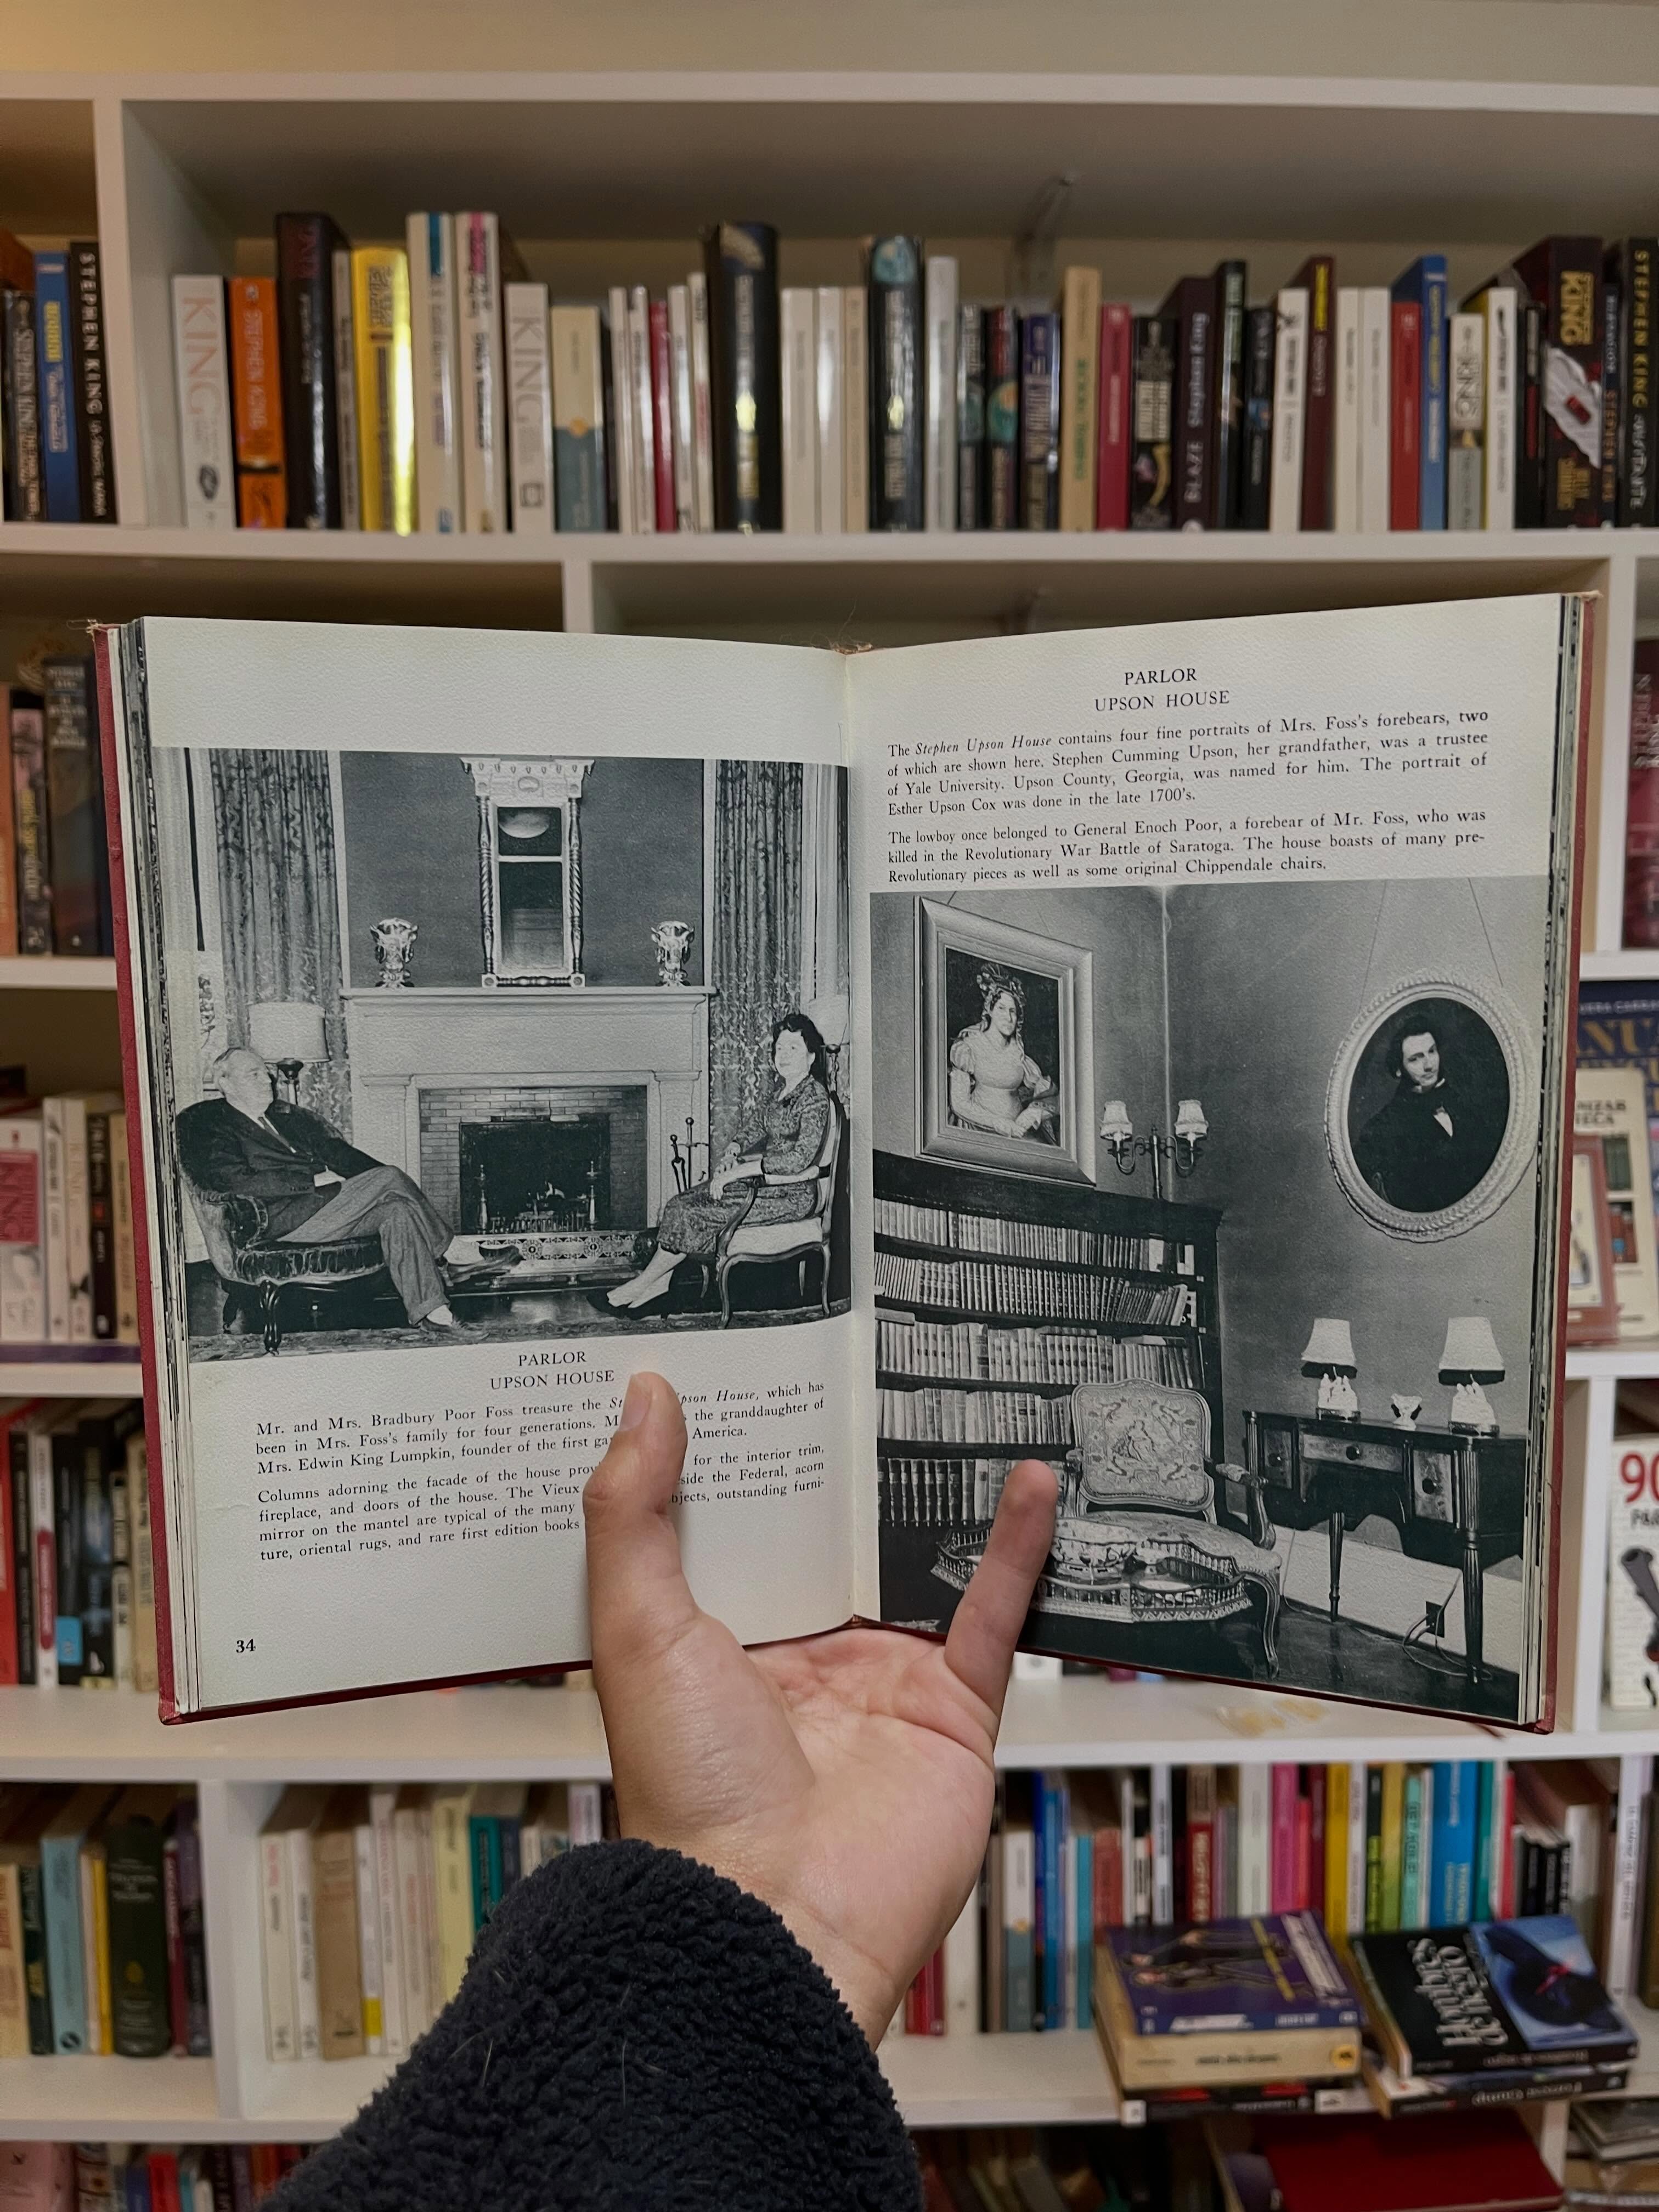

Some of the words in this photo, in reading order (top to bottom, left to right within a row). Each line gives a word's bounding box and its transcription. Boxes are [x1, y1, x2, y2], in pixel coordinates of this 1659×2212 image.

[79, 252, 99, 351] STEPHEN
[1634, 250, 1650, 347] STEPHEN
[182, 297, 223, 415] KING
[512, 316, 544, 422] KING
[84, 358, 103, 415] KING
[1632, 353, 1649, 408] KING
[1124, 668, 1198, 686] PARLOR
[1094, 695, 1155, 712] UPSON
[1166, 690, 1229, 708] HOUSE
[887, 743, 910, 758] The
[915, 741, 959, 757] Stephen
[967, 738, 1004, 754] Upson
[1011, 735, 1052, 749] House
[1058, 730, 1112, 746] contains
[1120, 728, 1149, 742] four
[1156, 725, 1182, 740] fine
[1189, 721, 1250, 741] portraits
[1257, 719, 1271, 733] of
[1280, 718, 1316, 732] Mrs.
[1325, 713, 1368, 730] Foss's
[1377, 711, 1450, 727] forebears,
[1459, 712, 1488, 723] two
[888, 763, 898, 777] of
[904, 760, 937, 776] which
[944, 763, 962, 773] are
[968, 758, 1006, 771] shown
[1014, 755, 1044, 769] here.
[1052, 751, 1103, 768] Stephen
[1111, 747, 1180, 763] Cumming
[1189, 744, 1238, 761] Upson,
[1248, 741, 1270, 755] her
[1278, 736, 1370, 758] grandfather,
[1380, 738, 1409, 748] was
[1418, 737, 1426, 747] a
[1436, 733, 1488, 746] trustee
[888, 801, 923, 816] Esther
[929, 800, 966, 815] Upson
[972, 798, 996, 811] Cox
[1002, 799, 1026, 810] was
[1032, 794, 1062, 808] done
[1069, 793, 1081, 806] in
[1088, 791, 1109, 805] the
[1116, 790, 1141, 804] late
[1150, 787, 1195, 803] 1700's.
[888, 850, 918, 864] killed
[924, 849, 934, 862] in
[941, 848, 958, 862] the
[965, 845, 1052, 861] Revolutionary
[1060, 843, 1092, 857] War
[1099, 841, 1140, 856] Battle
[1148, 840, 1161, 854] of
[1170, 839, 1234, 855] Saratoga.
[1242, 836, 1273, 850] The
[1282, 834, 1322, 849] house
[1330, 833, 1373, 848] boasts
[1381, 831, 1396, 846] of
[1406, 834, 1447, 847] many
[1455, 833, 1485, 847] pre-
[889, 868, 967, 883] Revolutionary
[973, 866, 1007, 883] pieces
[1014, 870, 1026, 878] as
[1032, 864, 1059, 878] well
[1066, 868, 1079, 877] as
[1086, 867, 1118, 876] some
[1125, 860, 1177, 878] original
[1185, 856, 1273, 875] Chippendale
[1280, 855, 1326, 870] chairs.
[490, 1374, 548, 1390] UPSON
[557, 1369, 614, 1385] HOUSE
[518, 1351, 587, 1367] PARLOR
[256, 1422, 284, 1436] Mr.
[294, 1418, 318, 1433] and
[328, 1417, 361, 1430] Mrs.
[371, 1412, 435, 1427] Bradbury
[445, 1409, 476, 1421] Poor
[486, 1406, 514, 1418] Foss
[522, 1404, 573, 1415] treasure
[582, 1398, 601, 1411] the
[677, 1392, 707, 1406] pson
[716, 1389, 759, 1402] House,
[766, 1383, 801, 1399] which
[809, 1381, 824, 1393] has
[256, 1442, 286, 1455] been
[295, 1439, 307, 1452] in
[316, 1436, 350, 1450] Mrs.
[359, 1432, 398, 1447] Foss's
[406, 1428, 448, 1443] family
[456, 1426, 476, 1439] for
[484, 1424, 512, 1437] four
[520, 1418, 595, 1437] generations.
[695, 1408, 713, 1421] the
[720, 1402, 808, 1422] granddaughter
[814, 1396, 823, 1410] of
[257, 1461, 291, 1475] Mrs.
[298, 1456, 343, 1471] Edwin
[351, 1453, 383, 1467] King
[390, 1447, 455, 1463] Lumpkin,
[461, 1442, 512, 1457] founder
[517, 1440, 531, 1453] of
[537, 1438, 556, 1451] the
[562, 1436, 588, 1449] first
[692, 1425, 746, 1439] America.
[259, 1506, 321, 1523] fireplace,
[330, 1500, 354, 1515] and
[364, 1499, 399, 1512] doors
[408, 1495, 421, 1509] of
[430, 1493, 450, 1506] the
[458, 1491, 498, 1504] house.
[505, 1486, 533, 1499] The
[543, 1483, 579, 1496] Vieux
[676, 1472, 704, 1485] side
[712, 1470, 731, 1483] the
[740, 1465, 787, 1481] Federal,
[795, 1462, 824, 1475] acorn
[260, 1550, 292, 1561] ture,
[299, 1539, 352, 1557] oriental
[359, 1539, 391, 1551] rugs,
[398, 1532, 421, 1546] and
[430, 1533, 455, 1543] rare
[462, 1527, 488, 1540] first
[495, 1522, 538, 1537] edition
[545, 1520, 579, 1532] books
[236, 1638, 256, 1653] 34
